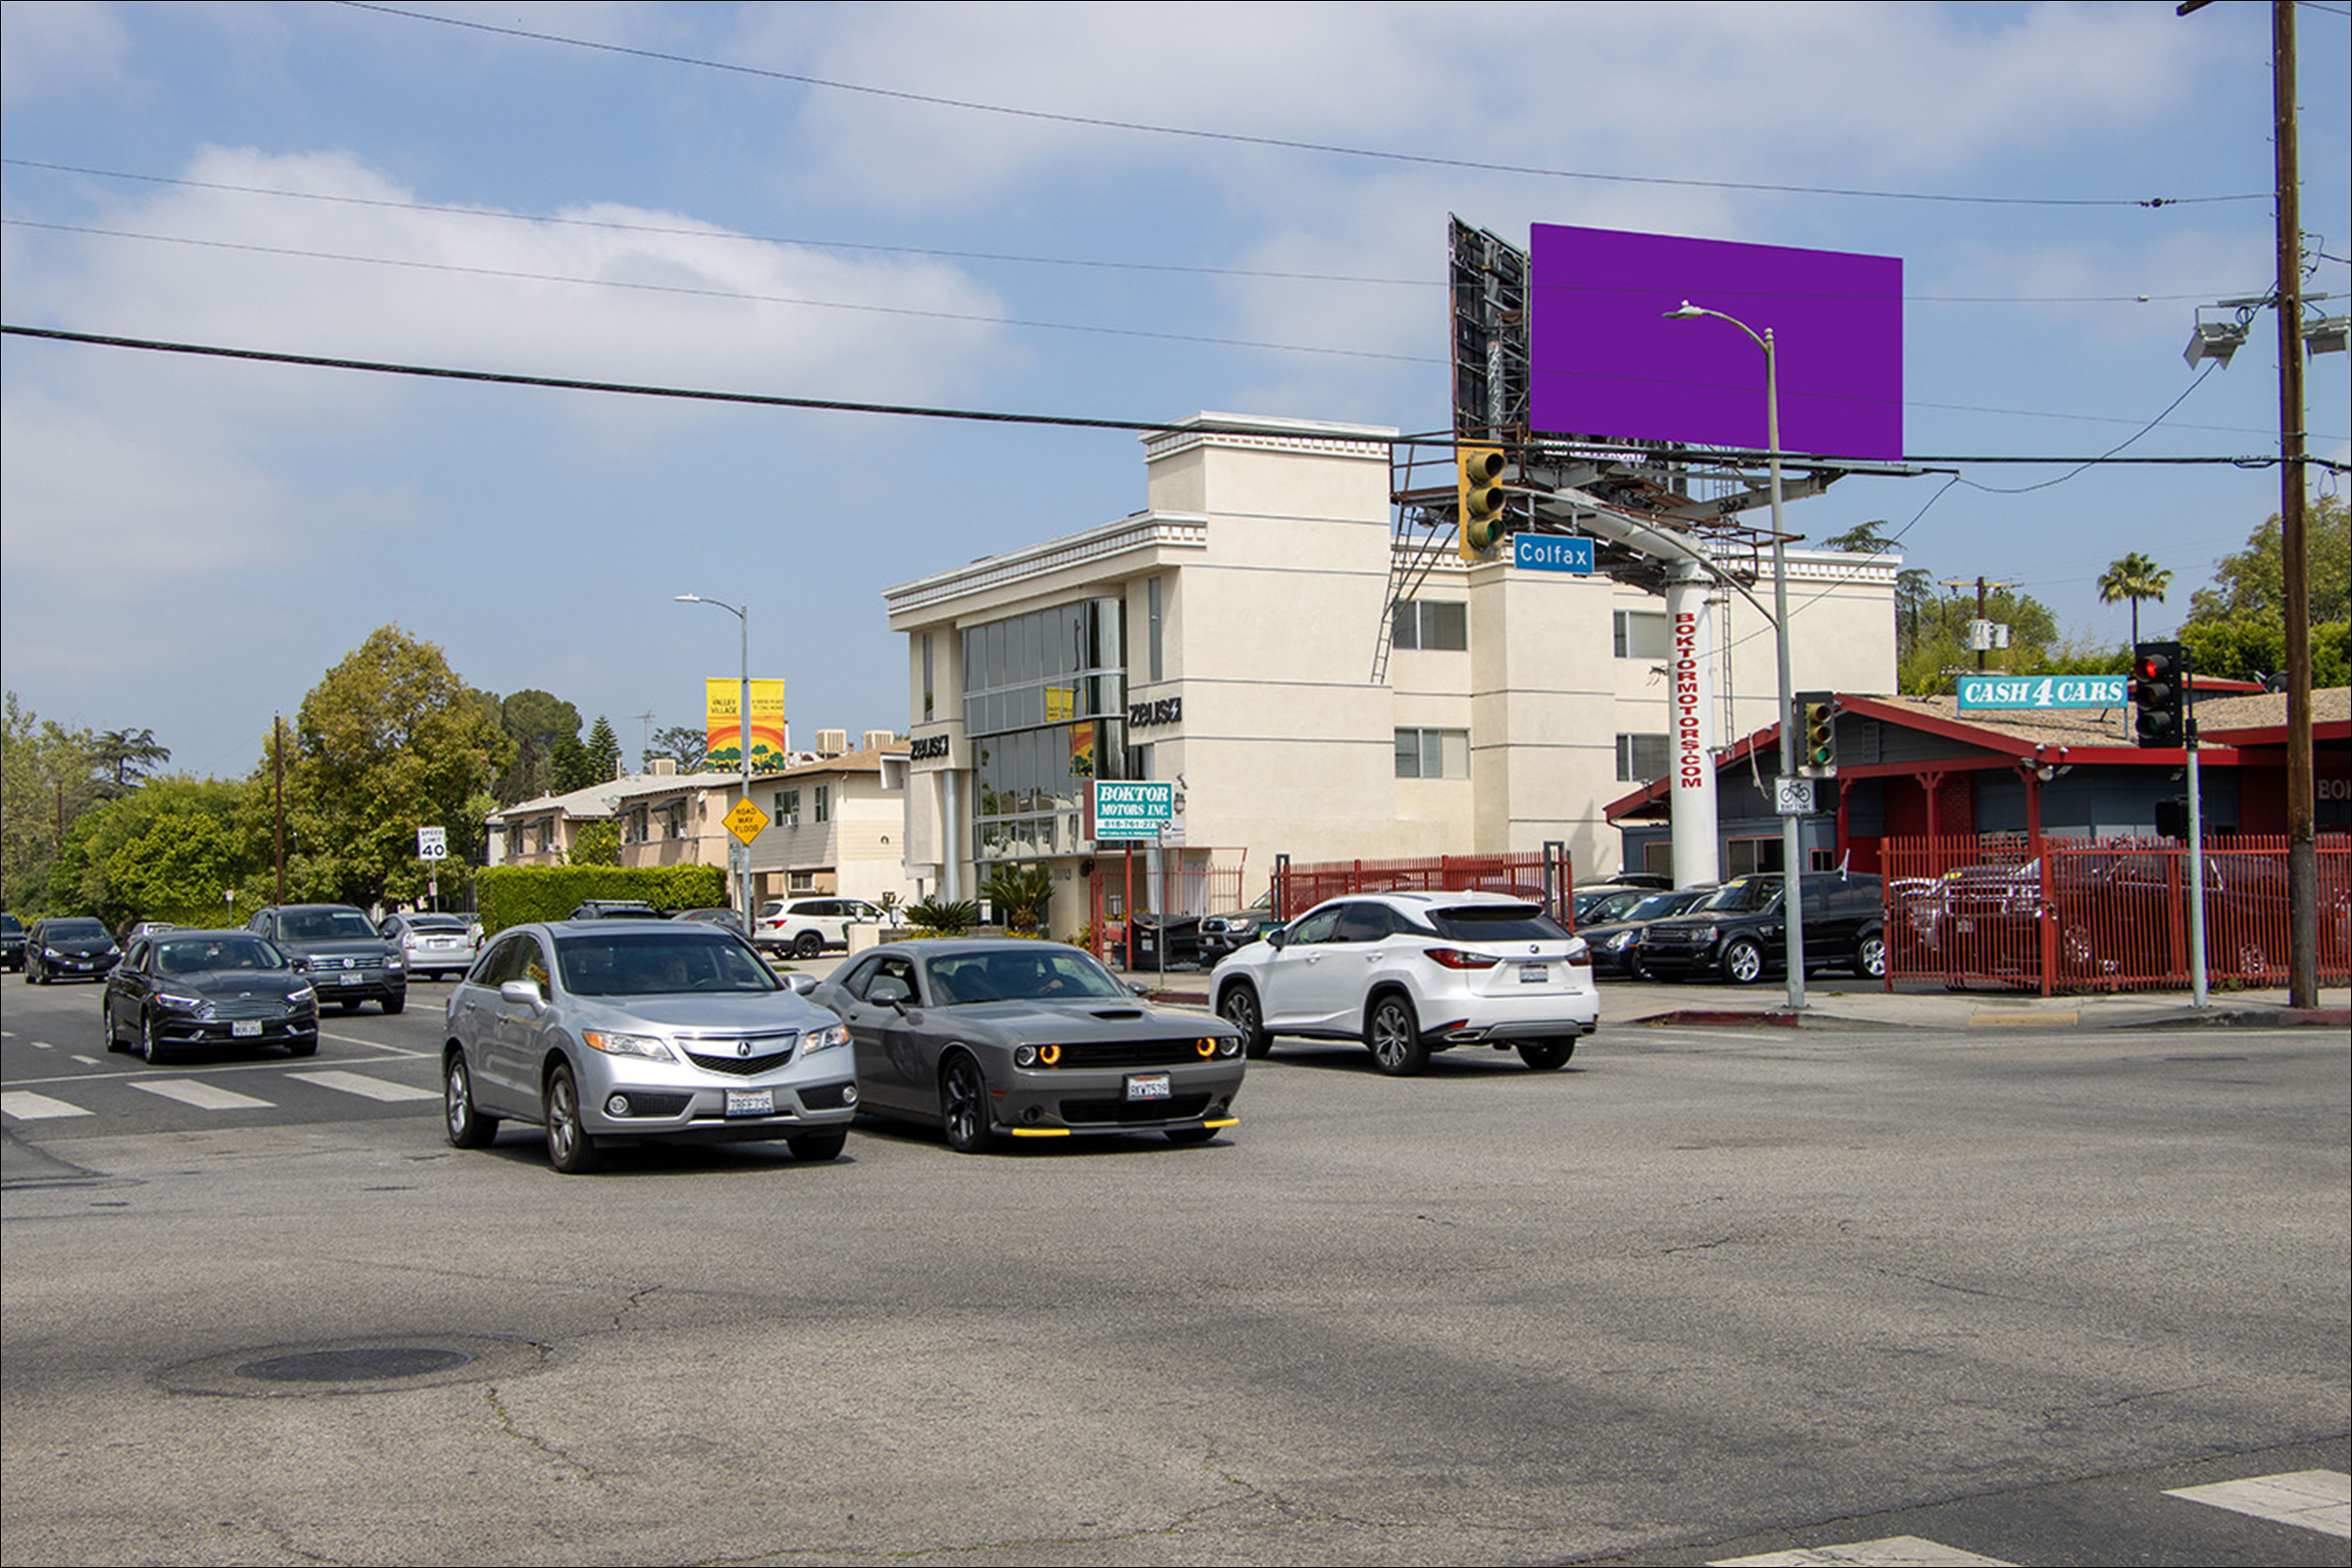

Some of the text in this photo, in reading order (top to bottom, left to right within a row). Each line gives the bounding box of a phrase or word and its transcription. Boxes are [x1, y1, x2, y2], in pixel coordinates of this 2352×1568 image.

[1520, 542, 1587, 565] Colfax
[1965, 678, 2124, 707] CASH 4 CARS
[1100, 786, 1168, 802] BOKTOR
[1100, 805, 1168, 815] MOTORS INC.
[734, 824, 760, 833] FLOOD
[421, 844, 445, 857] 40
